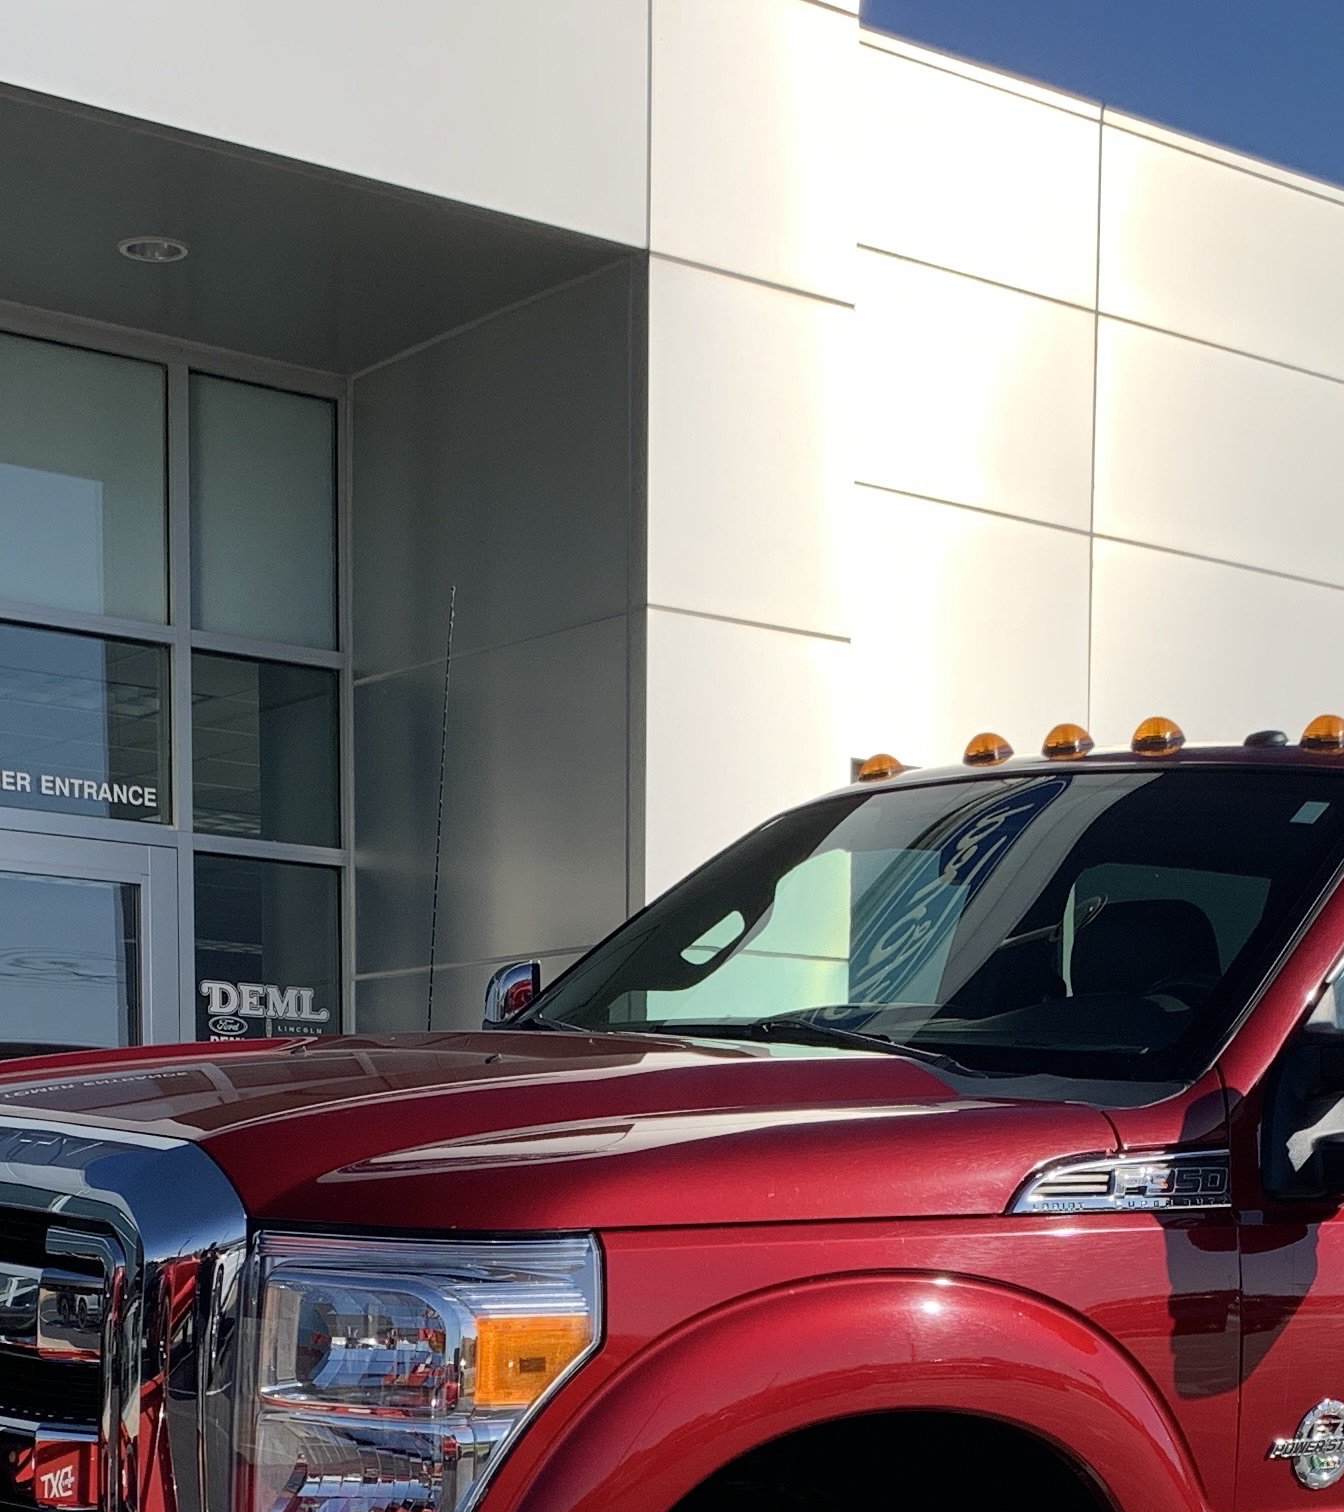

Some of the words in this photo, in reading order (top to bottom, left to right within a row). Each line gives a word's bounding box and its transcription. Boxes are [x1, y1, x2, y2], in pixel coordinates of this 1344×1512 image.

[41, 775, 157, 807] ENTRANCE
[199, 980, 330, 1022] DEML
[216, 1018, 239, 1032] Ford
[277, 1025, 322, 1034] LINCOLN
[1272, 1439, 1327, 1456] POWER
